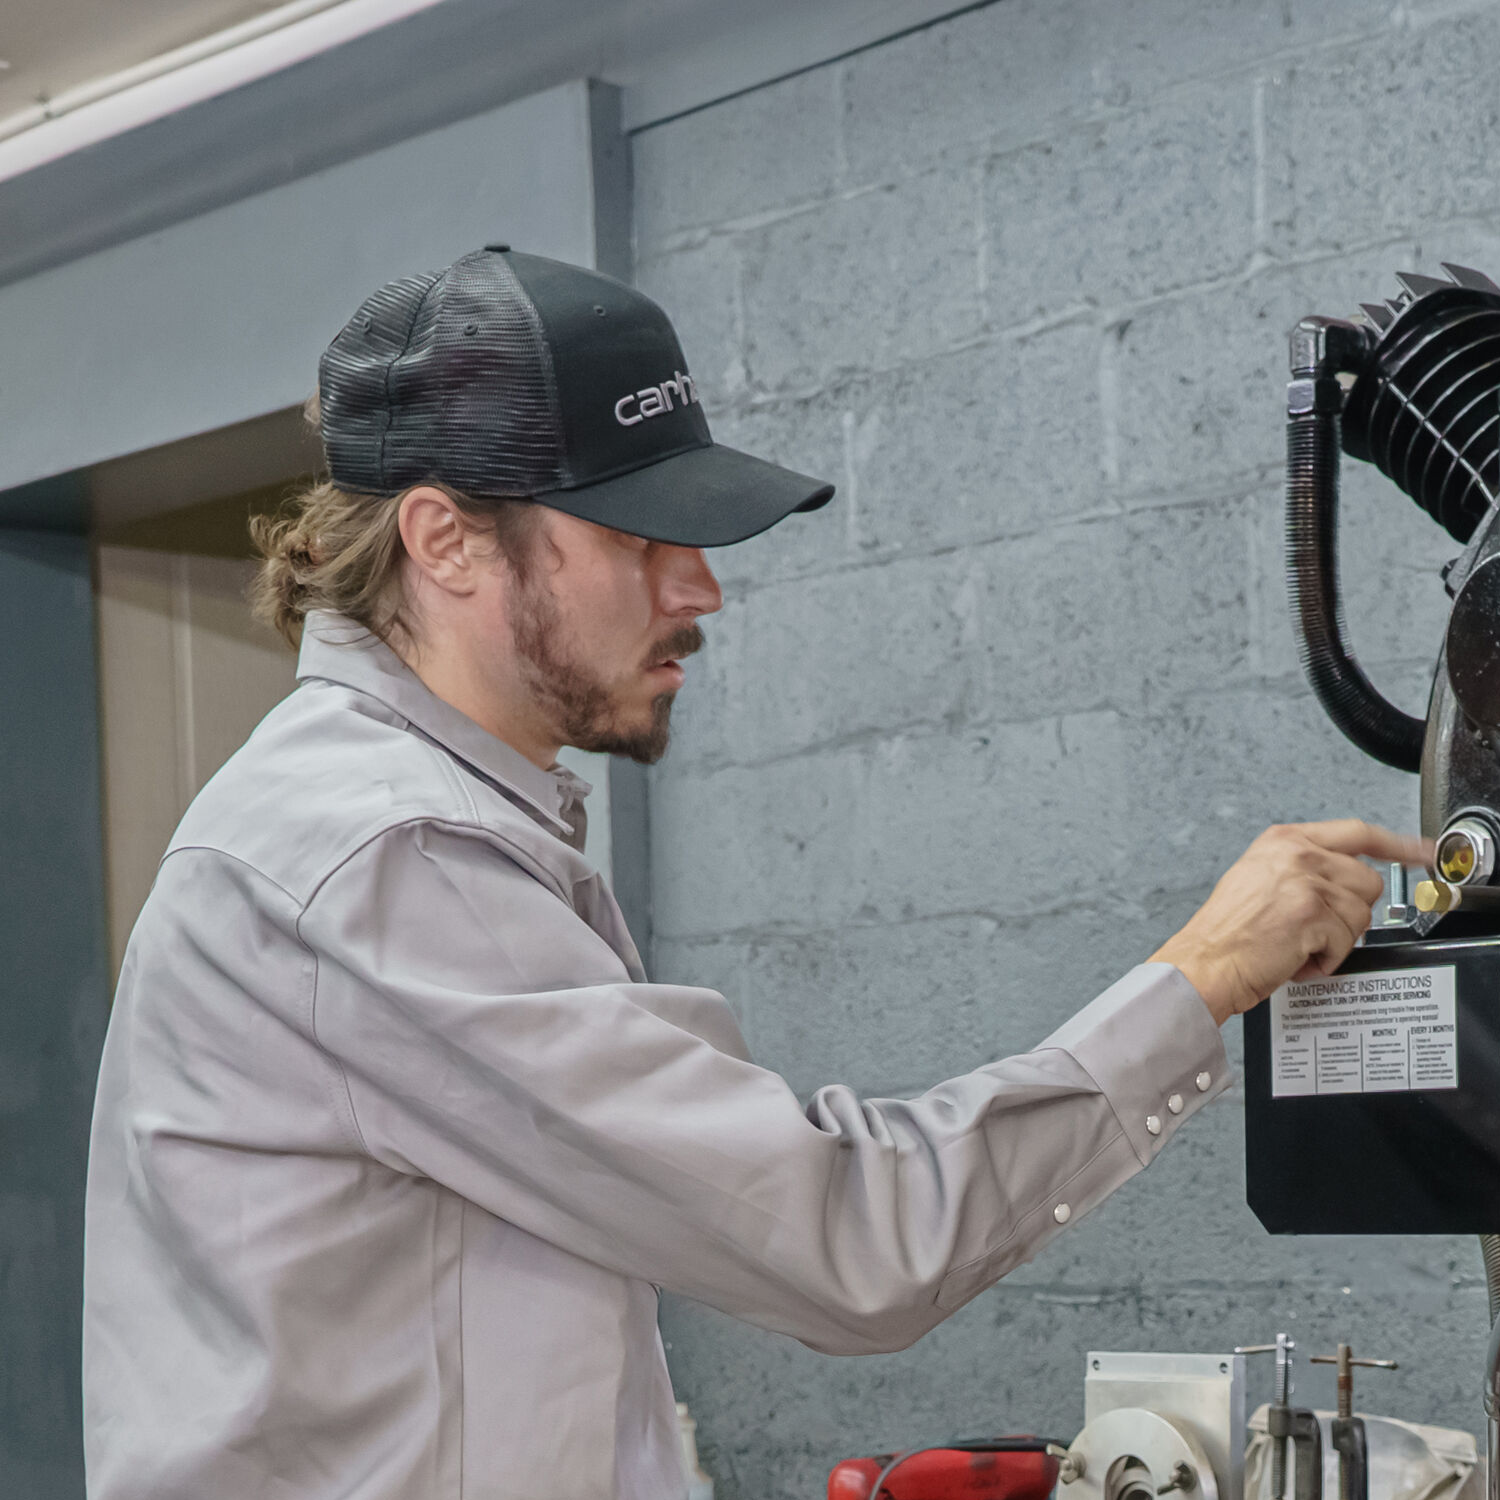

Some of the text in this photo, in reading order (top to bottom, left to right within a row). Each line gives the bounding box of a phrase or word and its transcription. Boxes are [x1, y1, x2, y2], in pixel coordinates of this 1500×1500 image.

[1288, 975, 1432, 997] MAINTENANCE INSTRUCTIONS
[1372, 1029, 1397, 1037] MONTHLY
[1410, 1026, 1427, 1035] EVERY
[1432, 1024, 1455, 1033] MONTHS
[1285, 1035, 1300, 1043] DAILY
[1328, 1032, 1349, 1040] WEEKLY
